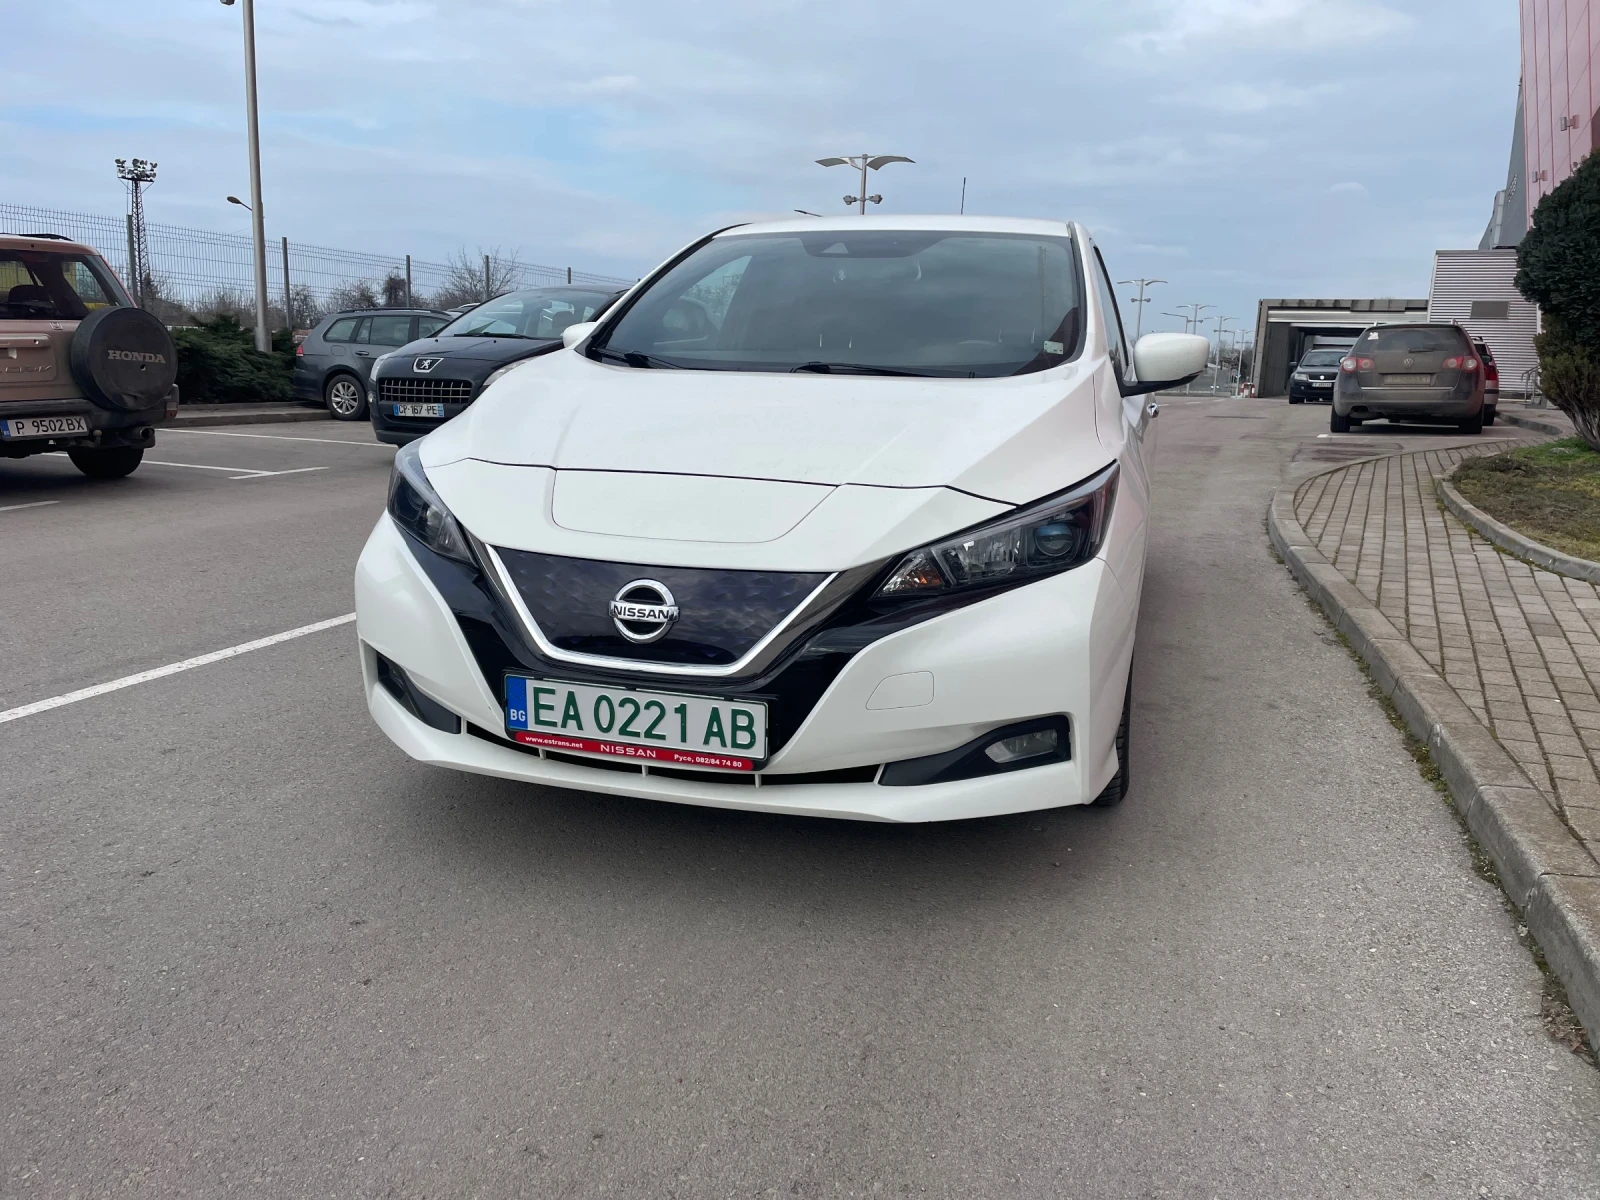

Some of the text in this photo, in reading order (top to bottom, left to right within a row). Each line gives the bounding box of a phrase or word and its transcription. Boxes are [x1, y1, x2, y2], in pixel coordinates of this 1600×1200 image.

[108, 350, 166, 364] HONDA
[15, 421, 25, 435] P
[32, 419, 65, 434] 9502
[613, 604, 669, 619] NISSAN
[510, 708, 526, 722] BG
[533, 686, 756, 750] EA 0221 AB
[525, 735, 583, 749] www.estrans.net
[600, 744, 656, 758] NISSAN
[695, 756, 720, 765] 082/84
[732, 760, 742, 768] 80
